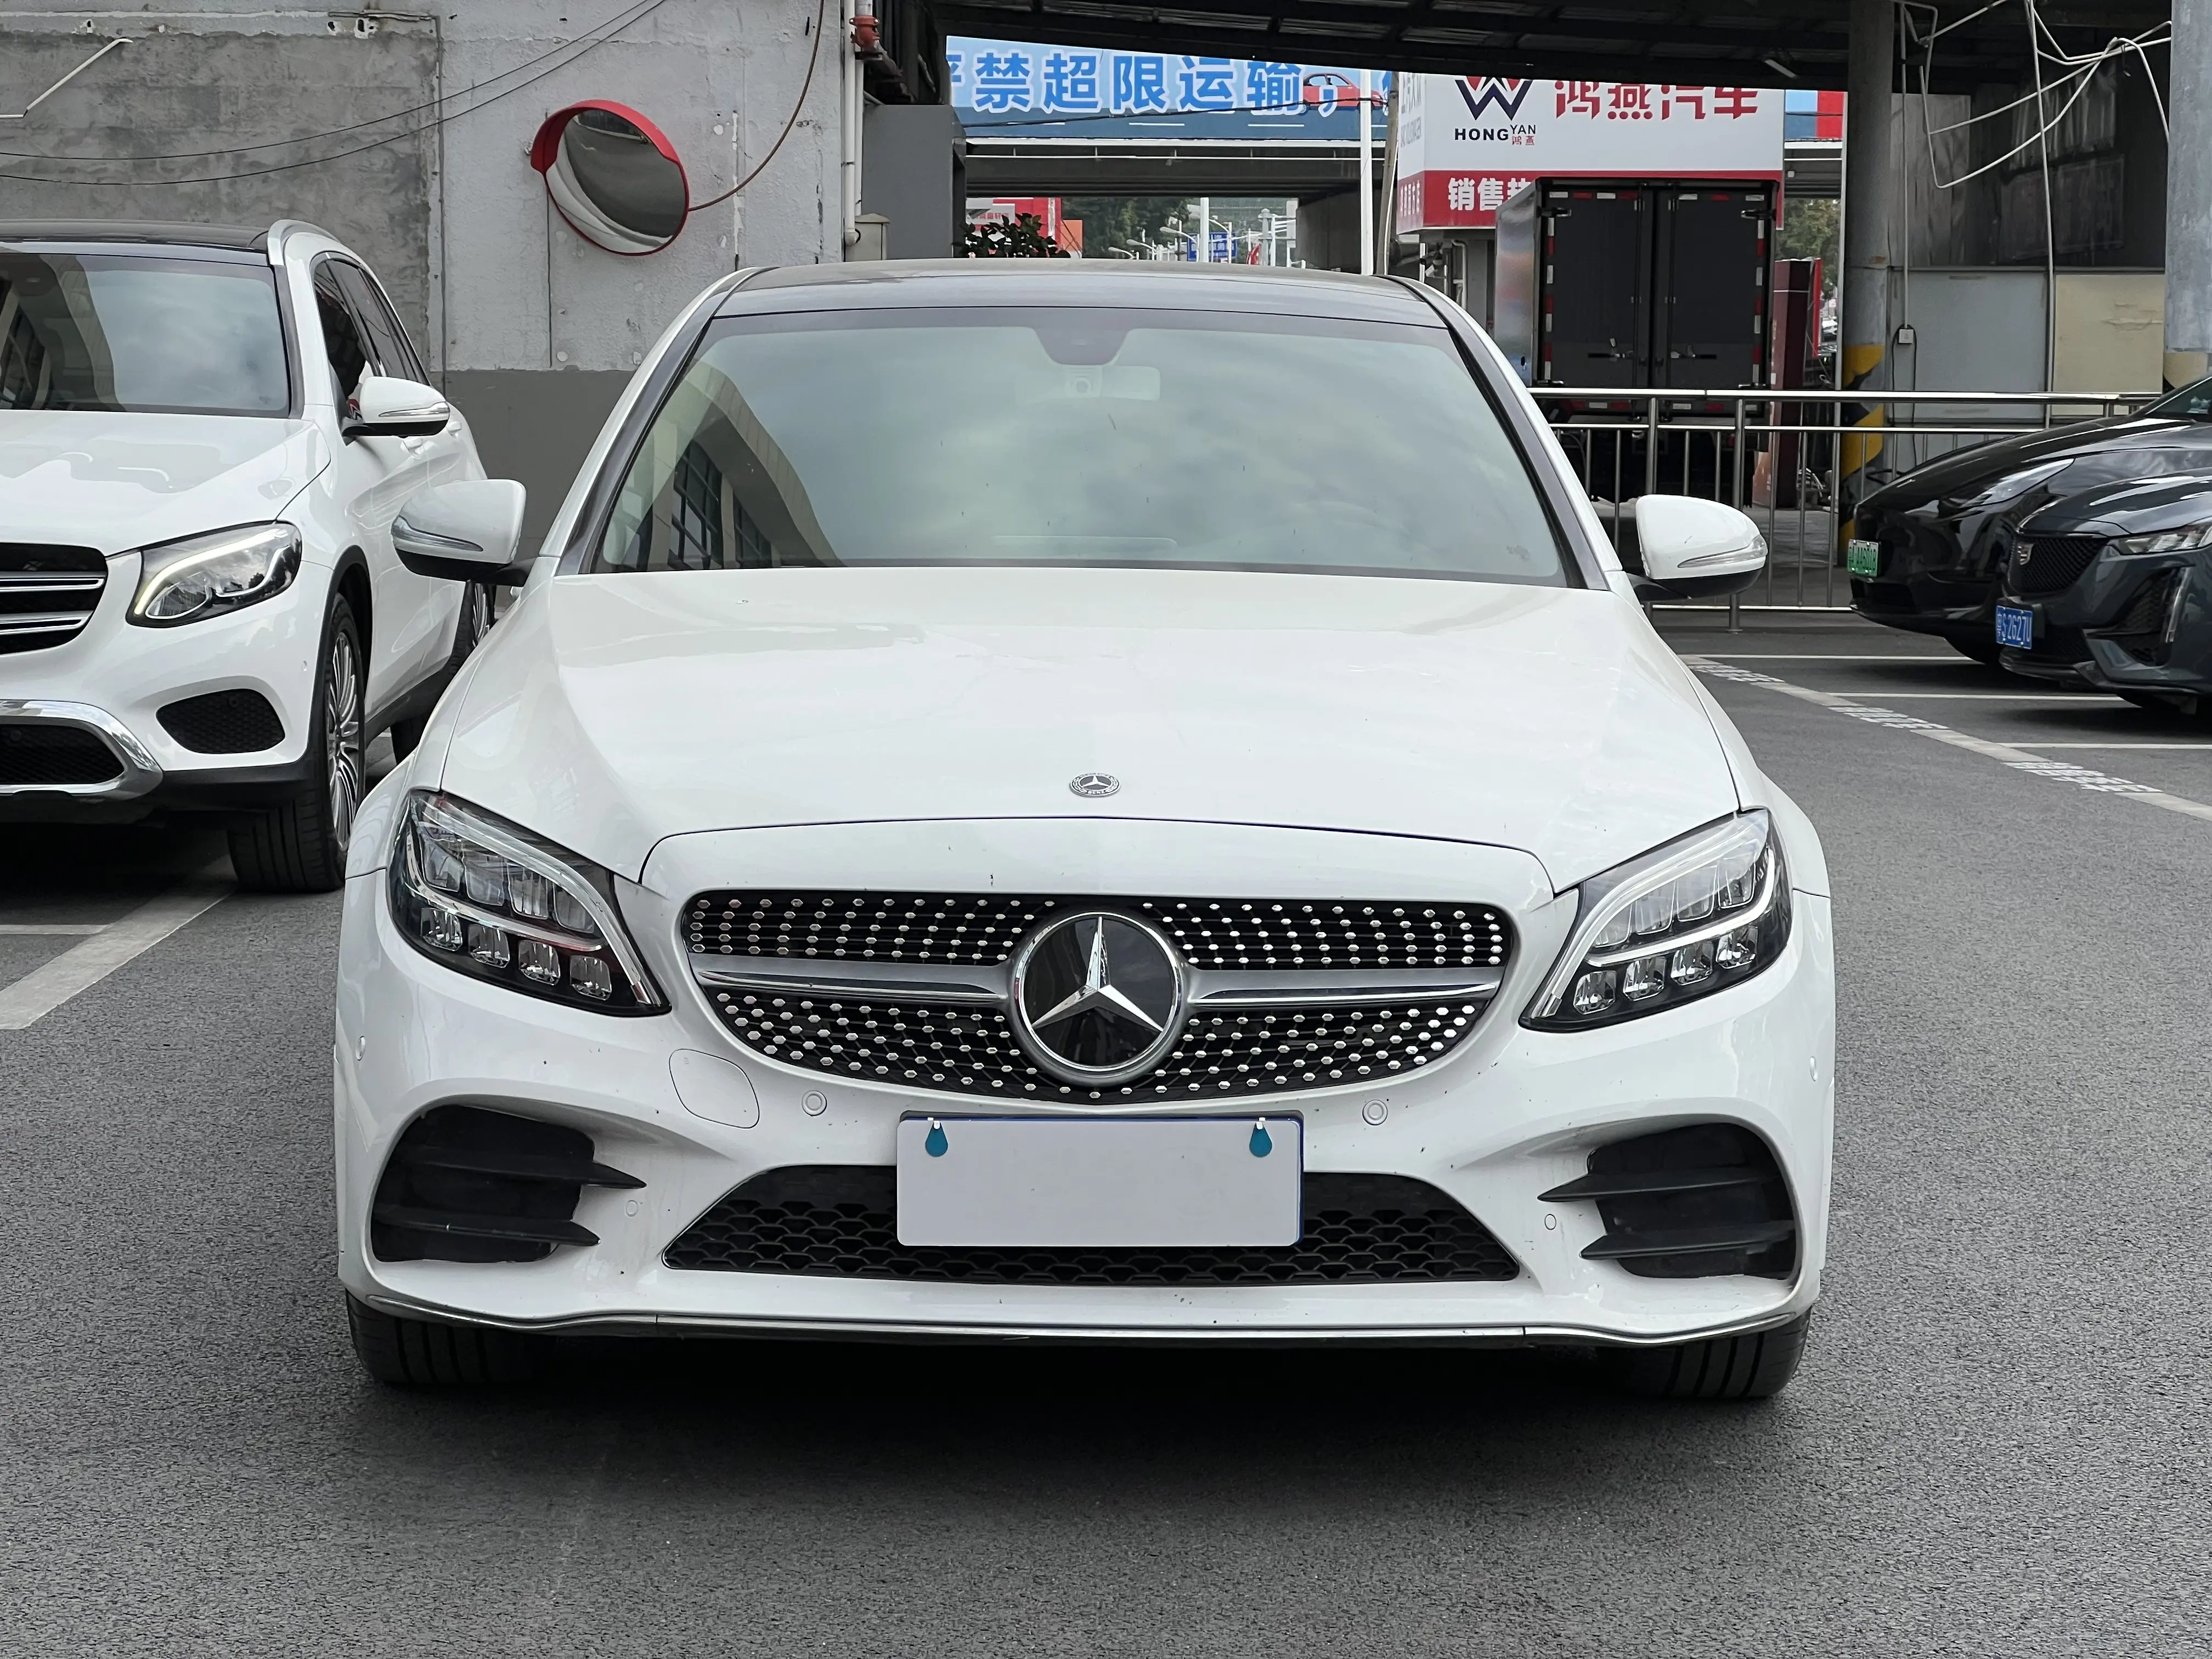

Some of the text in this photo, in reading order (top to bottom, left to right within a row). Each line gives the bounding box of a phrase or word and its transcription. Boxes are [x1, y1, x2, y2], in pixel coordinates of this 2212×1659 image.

[947, 52, 1391, 113] 禁超限运输，
[1554, 80, 1758, 120] 鸿燕汽车
[1454, 124, 1536, 140] HONG YAN
